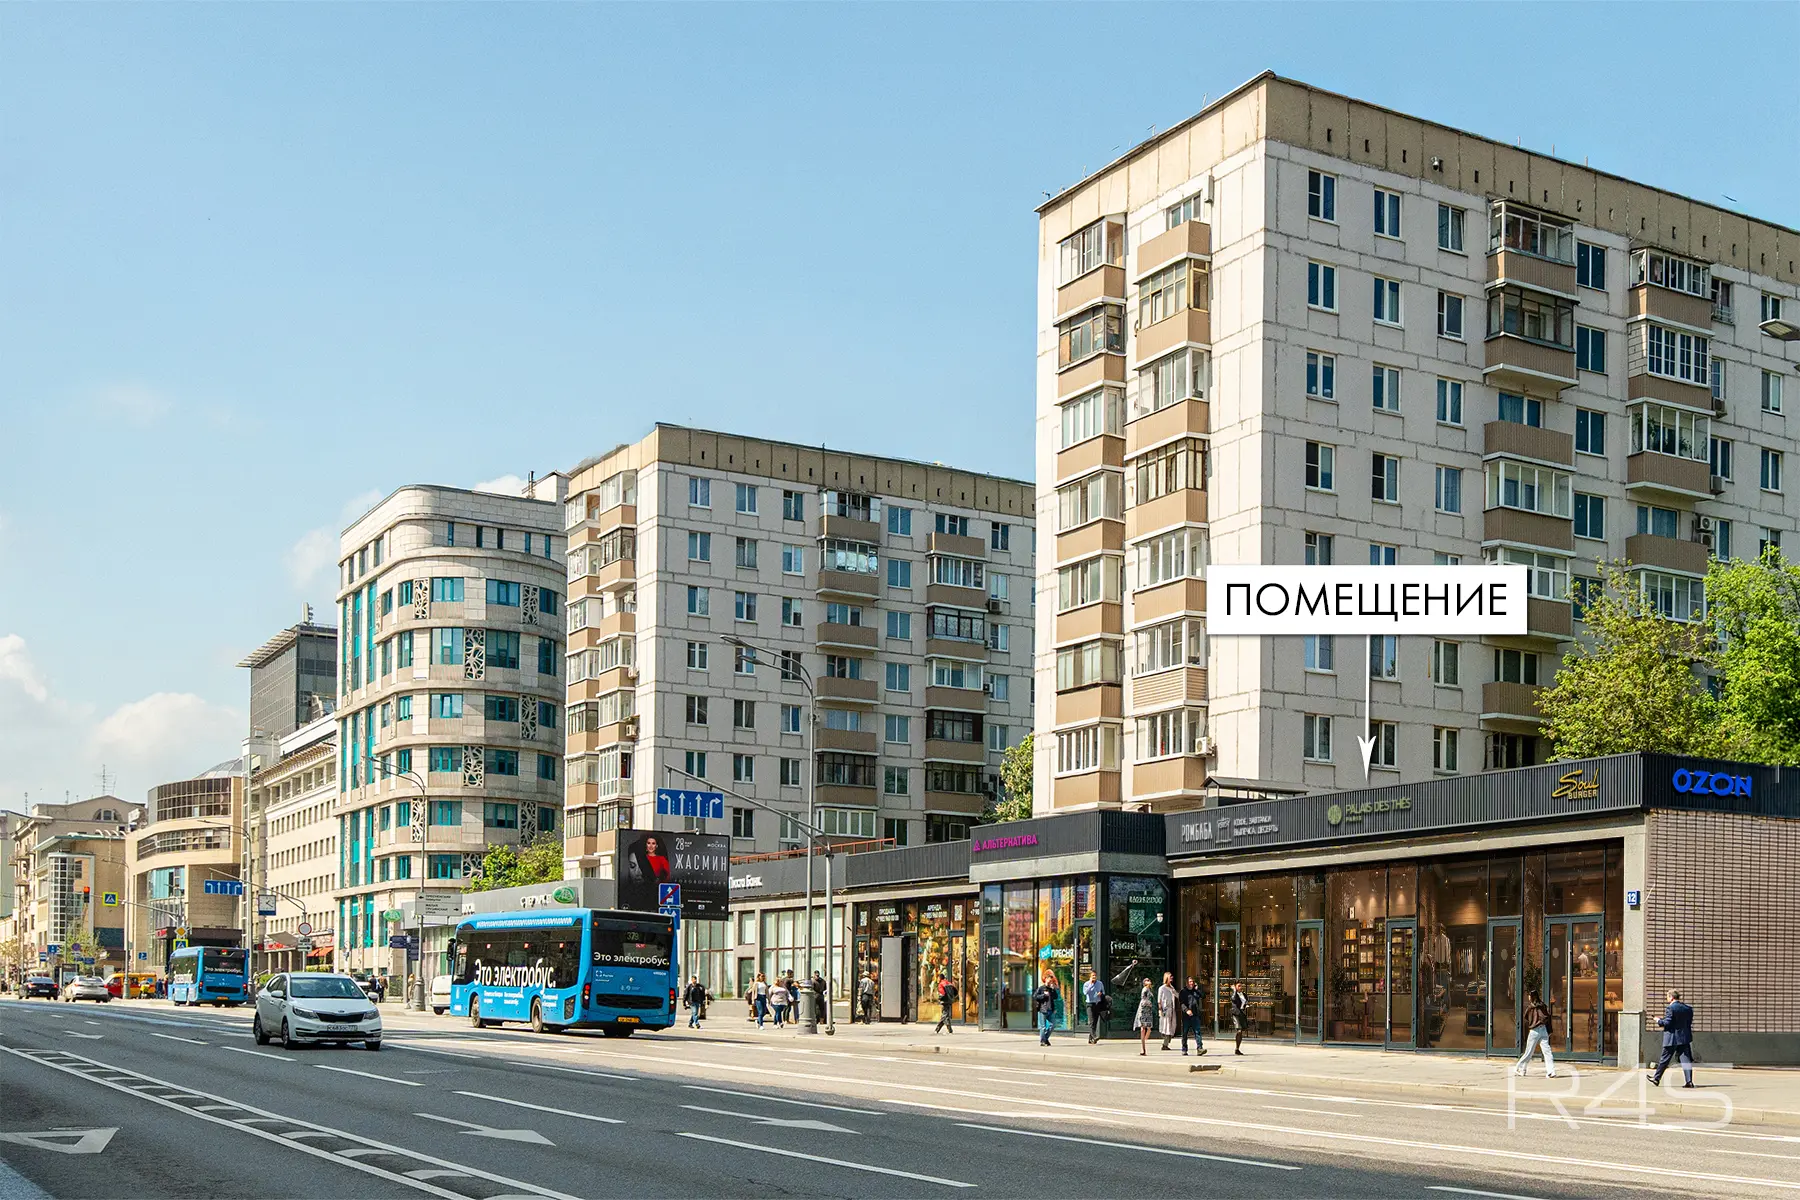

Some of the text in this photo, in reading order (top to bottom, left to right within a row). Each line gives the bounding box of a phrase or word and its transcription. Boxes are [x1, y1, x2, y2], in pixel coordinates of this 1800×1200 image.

[1552, 768, 1600, 798] Soul
[1672, 768, 1752, 798] OZON
[1568, 789, 1597, 801] BURGER
[1346, 802, 1373, 814] PALAIS
[1374, 801, 1390, 812] DES
[1182, 822, 1213, 842] РОМБАБА
[675, 837, 685, 851] 28
[982, 834, 1038, 850] АЛЬТЕРНАТИВА
[675, 853, 727, 871] ЖАСМИН
[1628, 892, 1636, 903] 12
[594, 951, 670, 966] Это электробус.
[473, 957, 556, 995] Это электробус.
